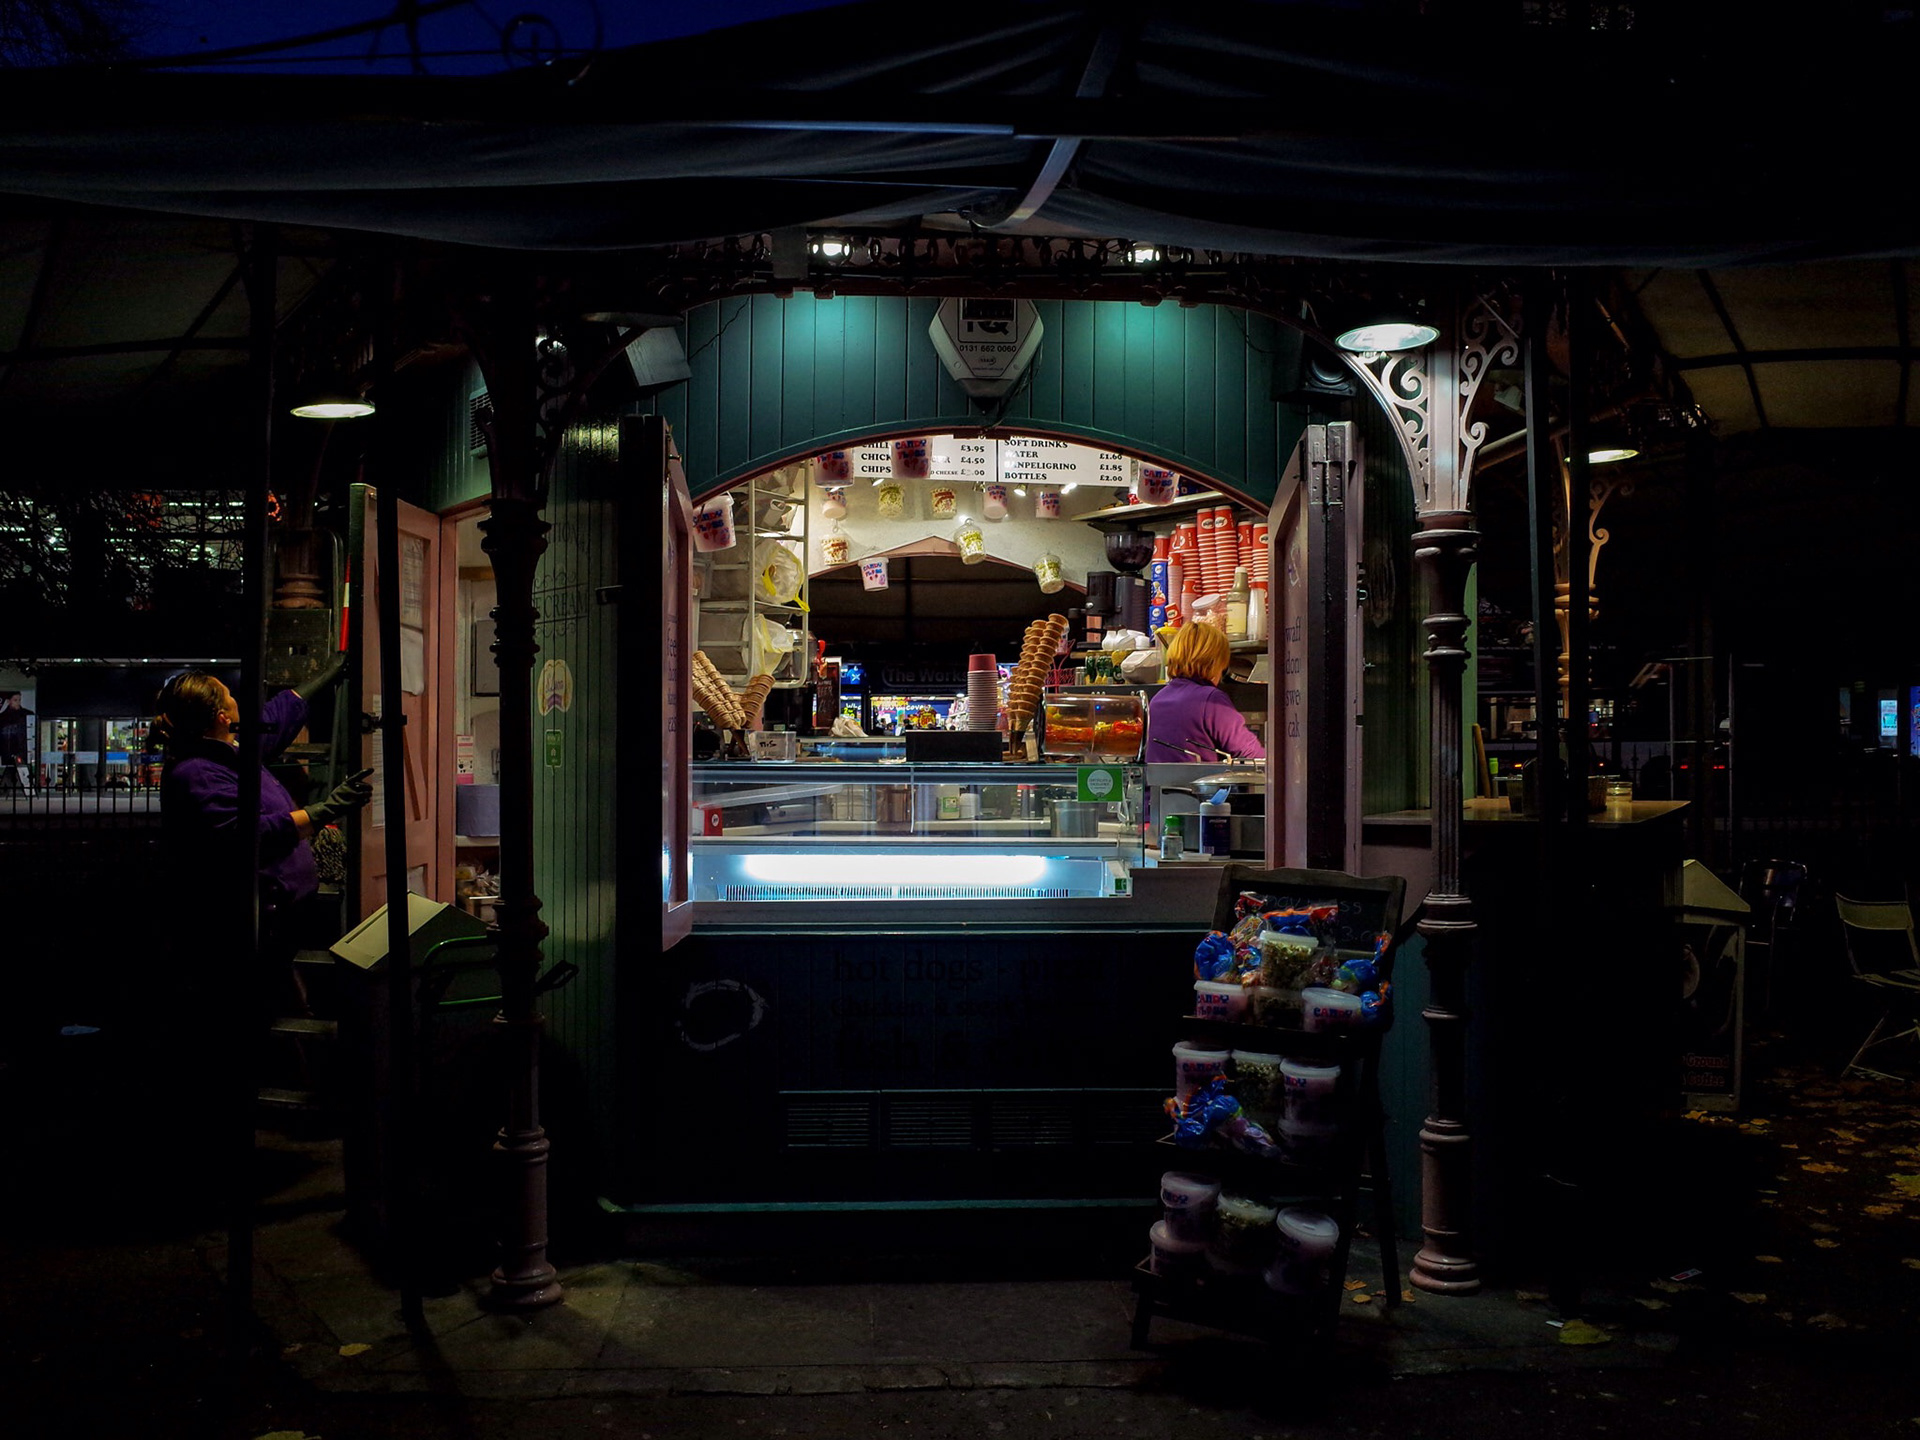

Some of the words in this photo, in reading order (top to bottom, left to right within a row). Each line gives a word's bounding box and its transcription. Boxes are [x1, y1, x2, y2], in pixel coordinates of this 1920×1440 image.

[959, 345, 978, 353] 0131
[960, 444, 985, 453] £3.95
[1004, 438, 1029, 447] SOFT
[1030, 439, 1069, 449] DRINKS
[960, 456, 986, 465] £4.50
[1099, 452, 1123, 460] £1.60
[860, 465, 892, 474] CHIPS
[1099, 463, 1123, 472] £1.85
[1004, 471, 1048, 481] BOTTLES
[1099, 474, 1123, 482] £2.00
[1143, 468, 1176, 479] CANDY
[887, 666, 915, 683] The
[832, 948, 890, 984] hot
[903, 948, 985, 991] dogs
[1313, 1007, 1353, 1018] CANDY
[1686, 1052, 1730, 1069] Ground
